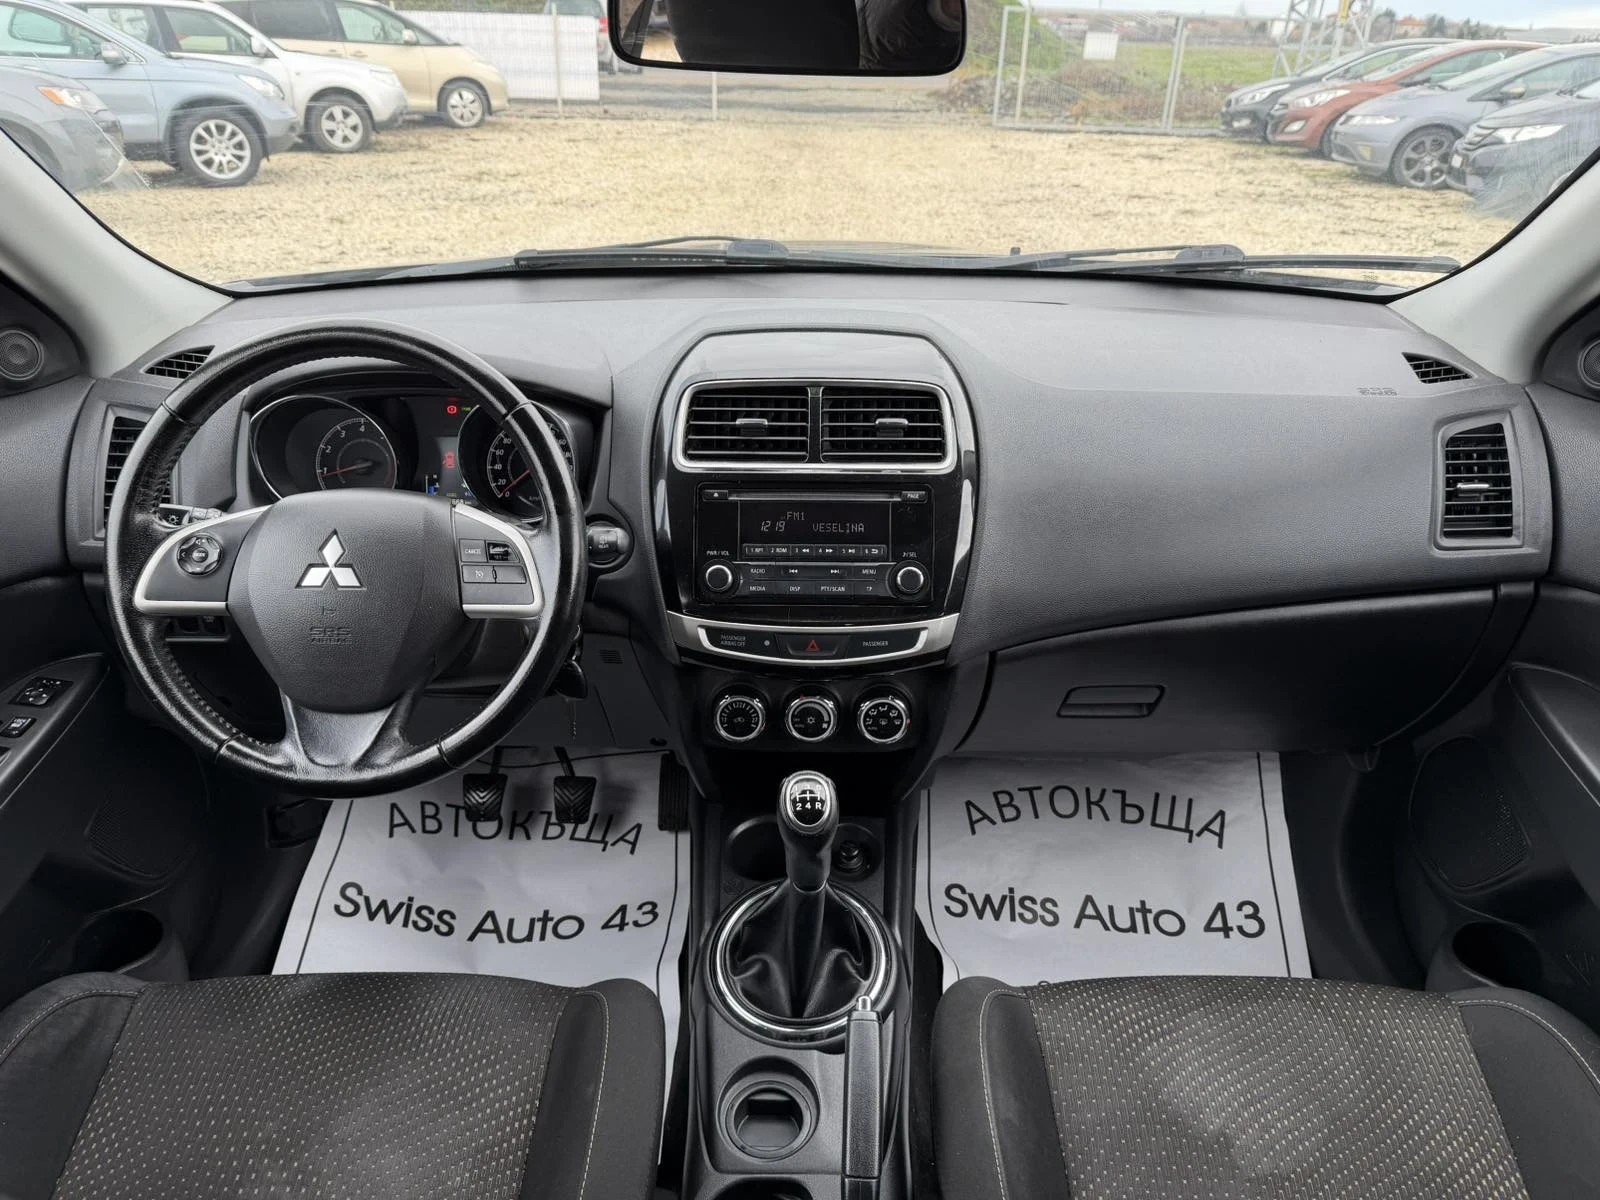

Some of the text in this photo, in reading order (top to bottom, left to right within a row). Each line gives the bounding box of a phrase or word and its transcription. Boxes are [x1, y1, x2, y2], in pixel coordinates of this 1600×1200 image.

[340, 430, 346, 438] 3
[325, 445, 332, 453] 2
[786, 511, 805, 520] FM1
[812, 523, 865, 533] VESELINA
[796, 802, 802, 810] 2
[815, 802, 822, 810] R
[963, 784, 1227, 849] АВТОКЪЩА
[333, 881, 660, 944] Swiss Auto 43
[943, 883, 1266, 939] Swiss Auto 43
